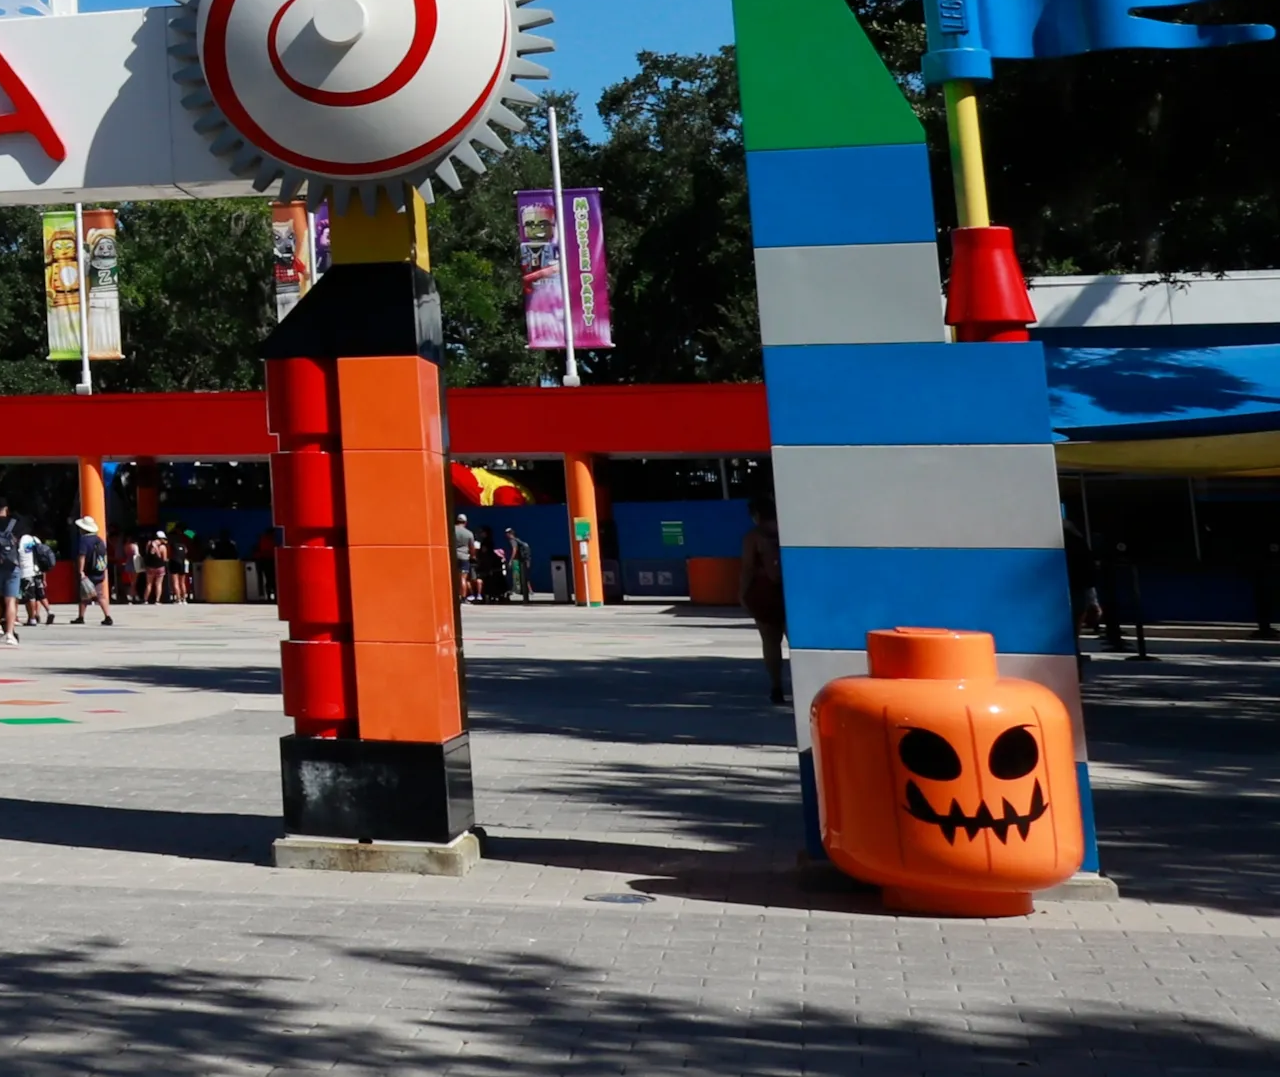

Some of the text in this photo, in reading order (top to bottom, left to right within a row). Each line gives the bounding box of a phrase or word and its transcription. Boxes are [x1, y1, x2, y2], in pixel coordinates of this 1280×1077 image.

[98, 269, 112, 285] Z
[573, 196, 595, 327] MONSTER PARTY
